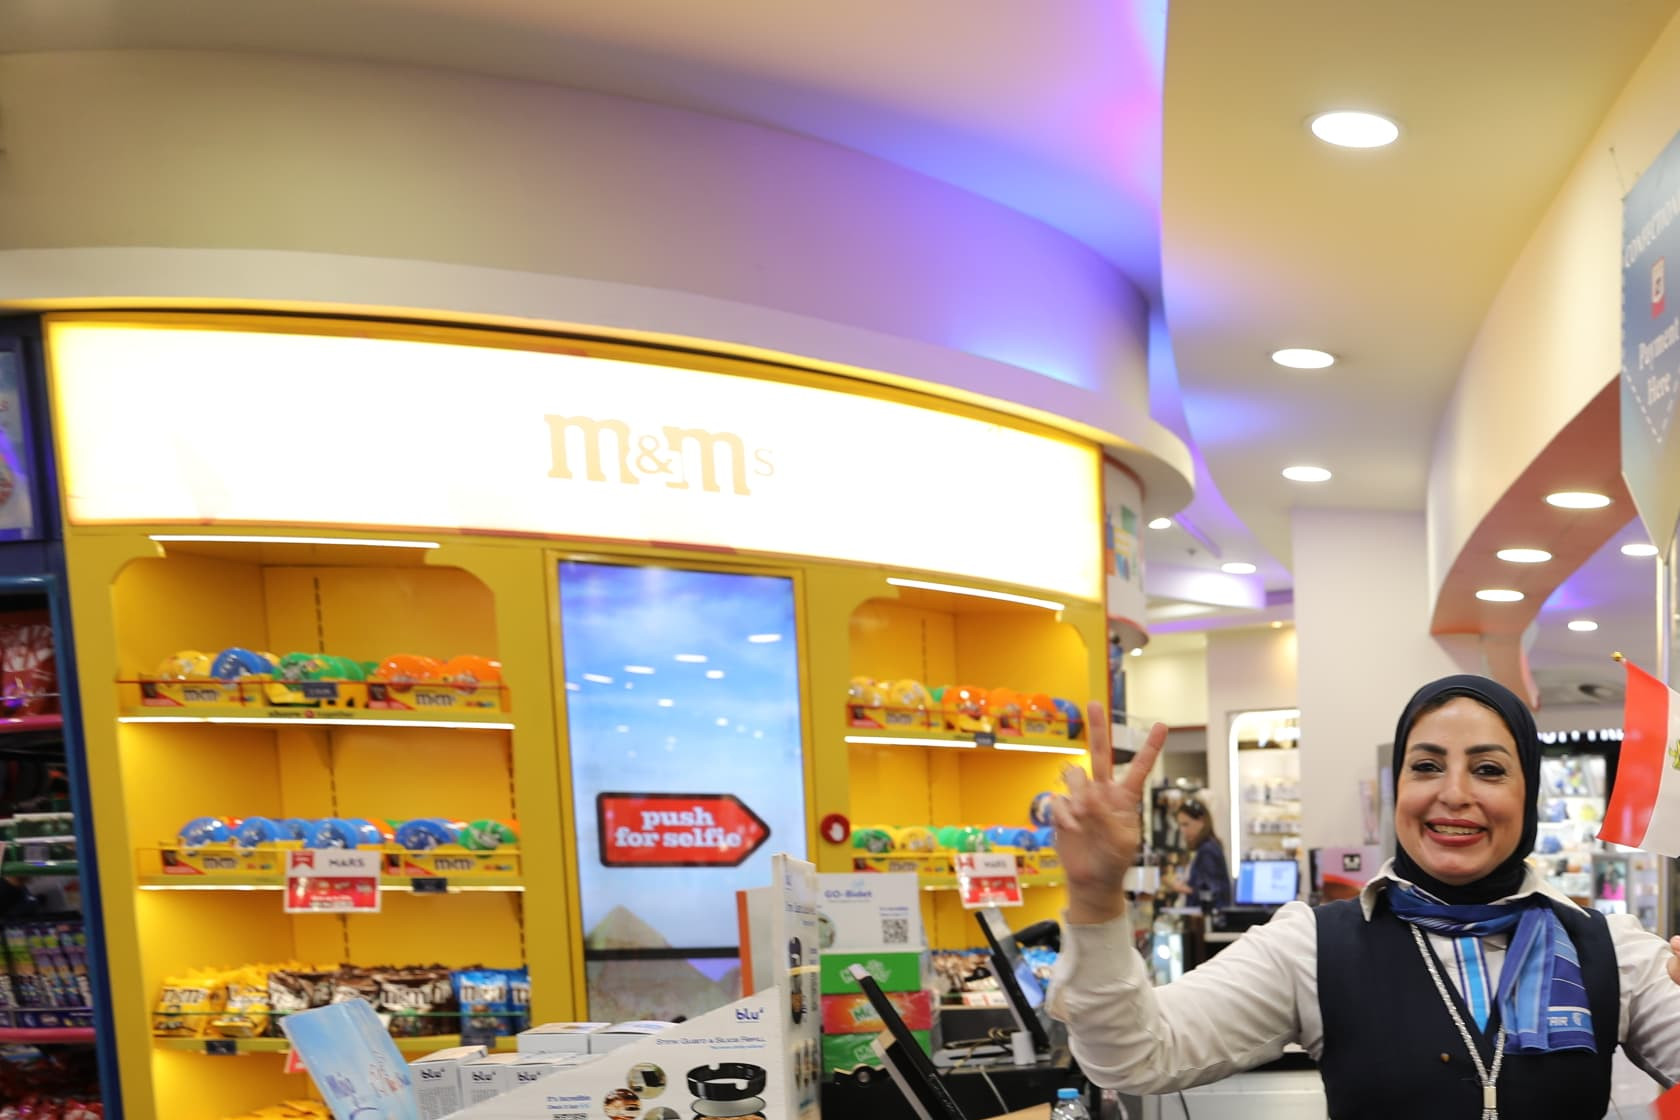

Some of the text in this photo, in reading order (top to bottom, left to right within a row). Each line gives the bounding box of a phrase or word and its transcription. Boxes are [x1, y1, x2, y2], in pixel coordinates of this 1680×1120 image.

[1638, 316, 1680, 372] Payment
[1646, 372, 1672, 406] Here
[640, 806, 715, 831] push
[615, 826, 742, 848] for selfie
